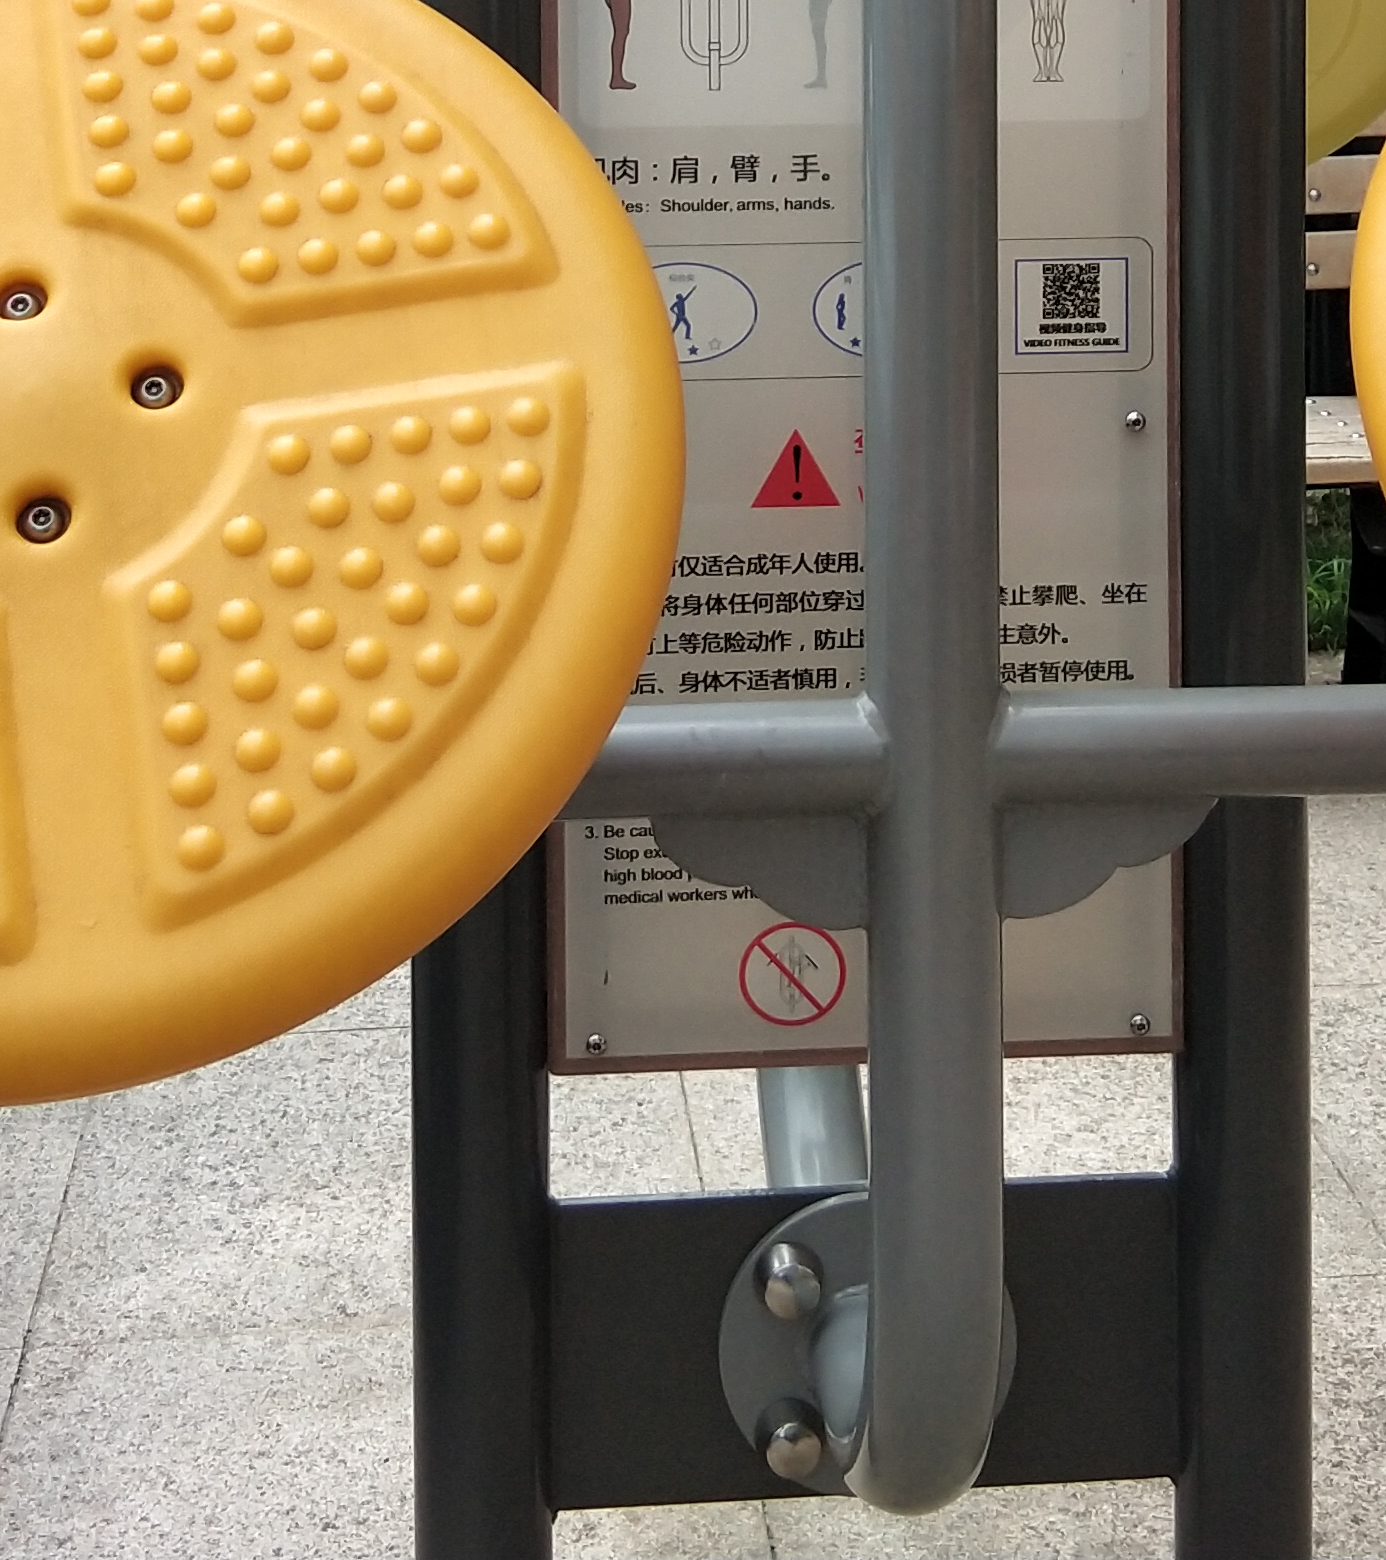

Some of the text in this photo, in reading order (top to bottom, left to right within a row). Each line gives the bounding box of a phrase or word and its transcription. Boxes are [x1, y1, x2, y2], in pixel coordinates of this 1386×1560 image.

[660, 197, 734, 213] Shoulder,
[736, 200, 780, 213] arms,
[784, 197, 836, 211] hands.
[1023, 337, 1121, 348] VIDEO FITNESS GUIDE
[671, 551, 865, 578] 仅适合成年人使用。
[645, 626, 865, 656] 上等危险动作，防止
[630, 666, 865, 696] 后、身体不适者慎用，
[584, 825, 599, 840] 3.
[603, 824, 625, 839] Be
[603, 846, 640, 863] Stop
[603, 868, 637, 886] high
[641, 867, 683, 882] blood
[603, 887, 760, 906] medical workers wh
